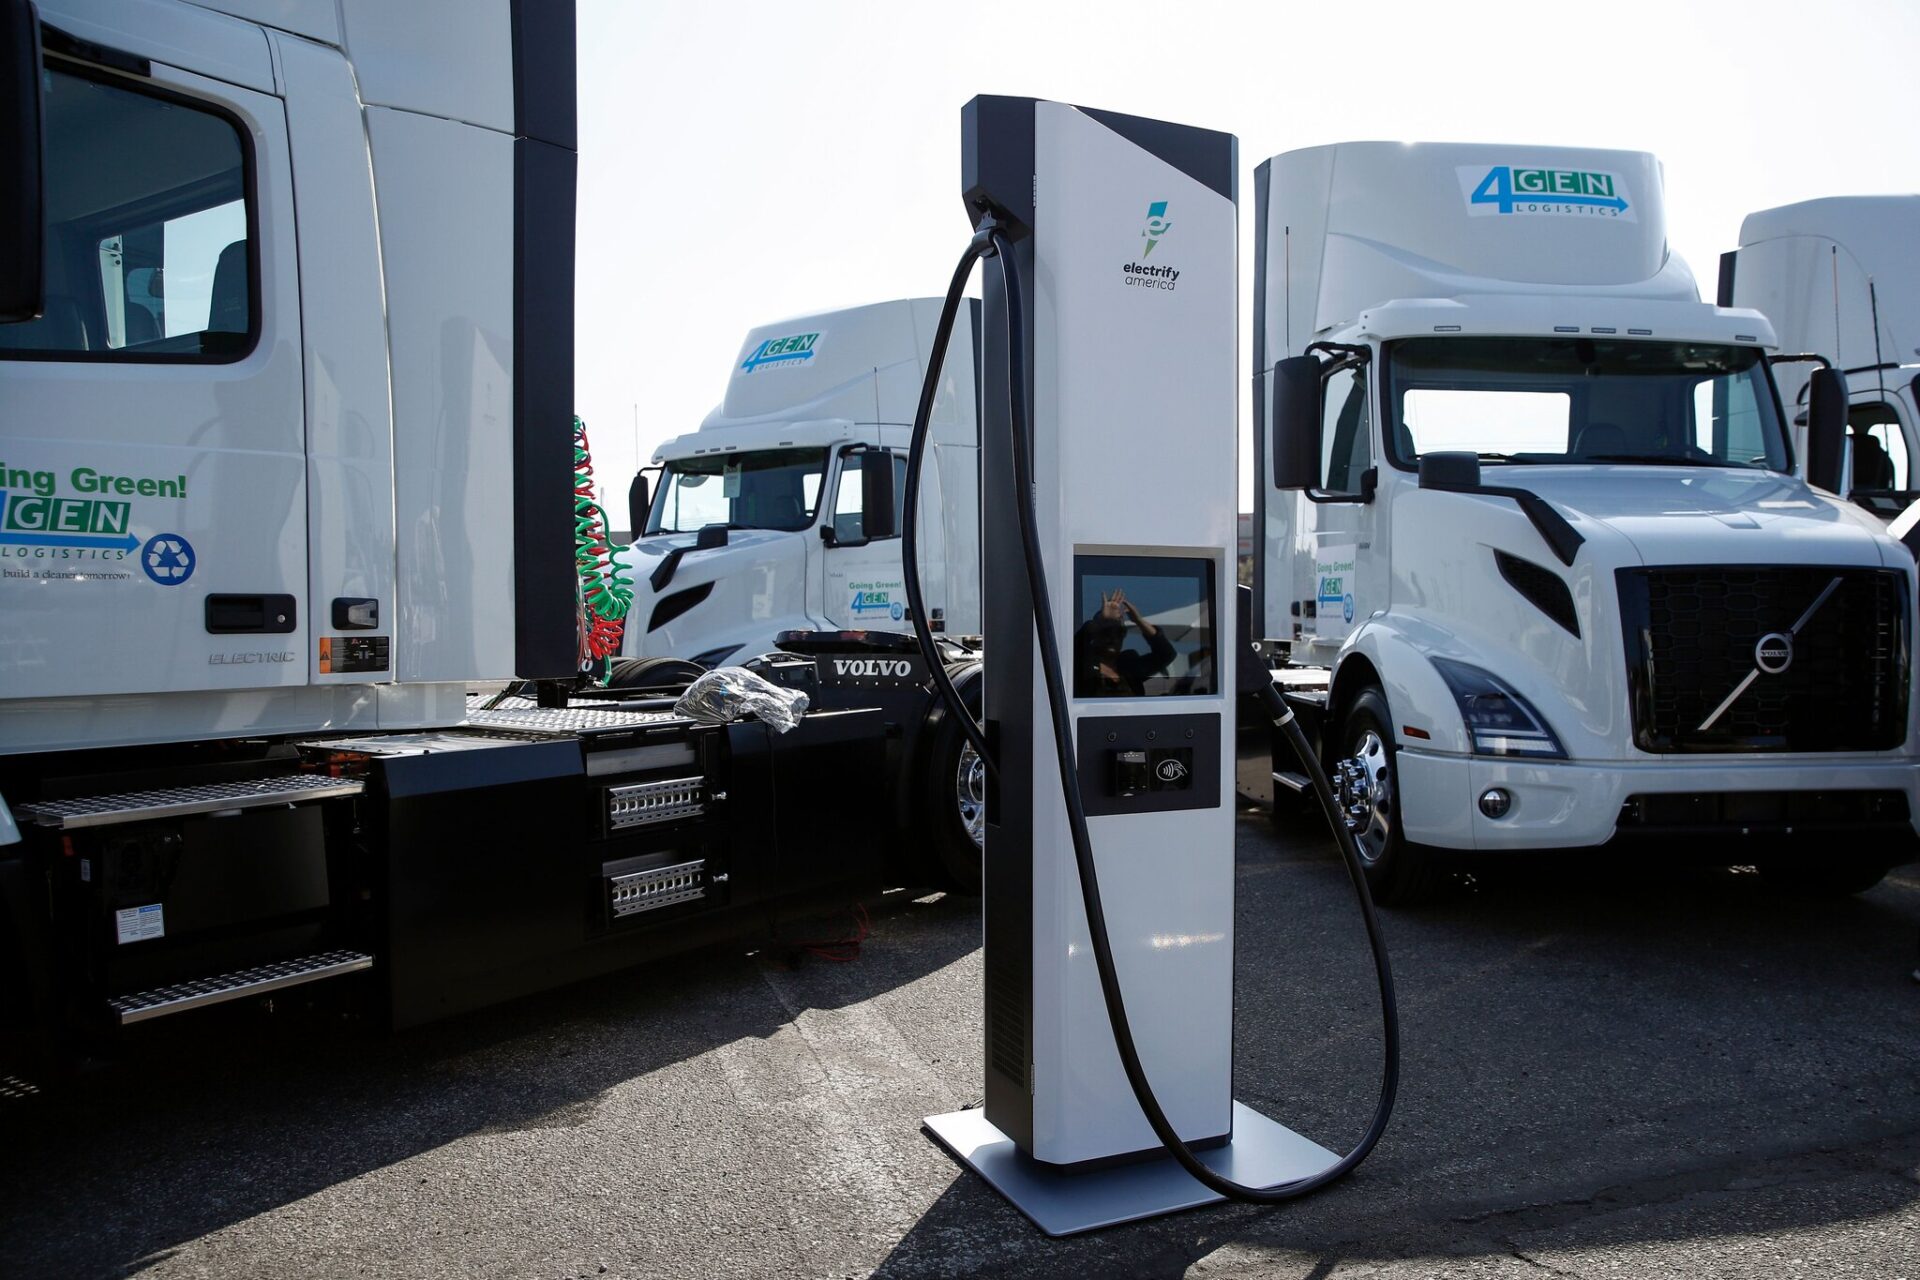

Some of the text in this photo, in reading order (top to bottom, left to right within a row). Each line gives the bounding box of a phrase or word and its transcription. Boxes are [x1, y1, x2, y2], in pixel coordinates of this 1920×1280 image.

[1471, 166, 1614, 213] 4GEN
[1516, 204, 1618, 217] LOGISTICS
[1123, 262, 1180, 281] electrify
[1125, 276, 1176, 290] america
[71, 467, 187, 498] Green!
[0, 490, 131, 533] GEN
[2, 547, 124, 560] LOGISTICS
[3, 569, 30, 579] build
[42, 570, 77, 579] cleaner
[849, 581, 902, 590] Going Green!
[208, 652, 295, 666] ELECTRIC
[833, 659, 912, 677] VOLVO
